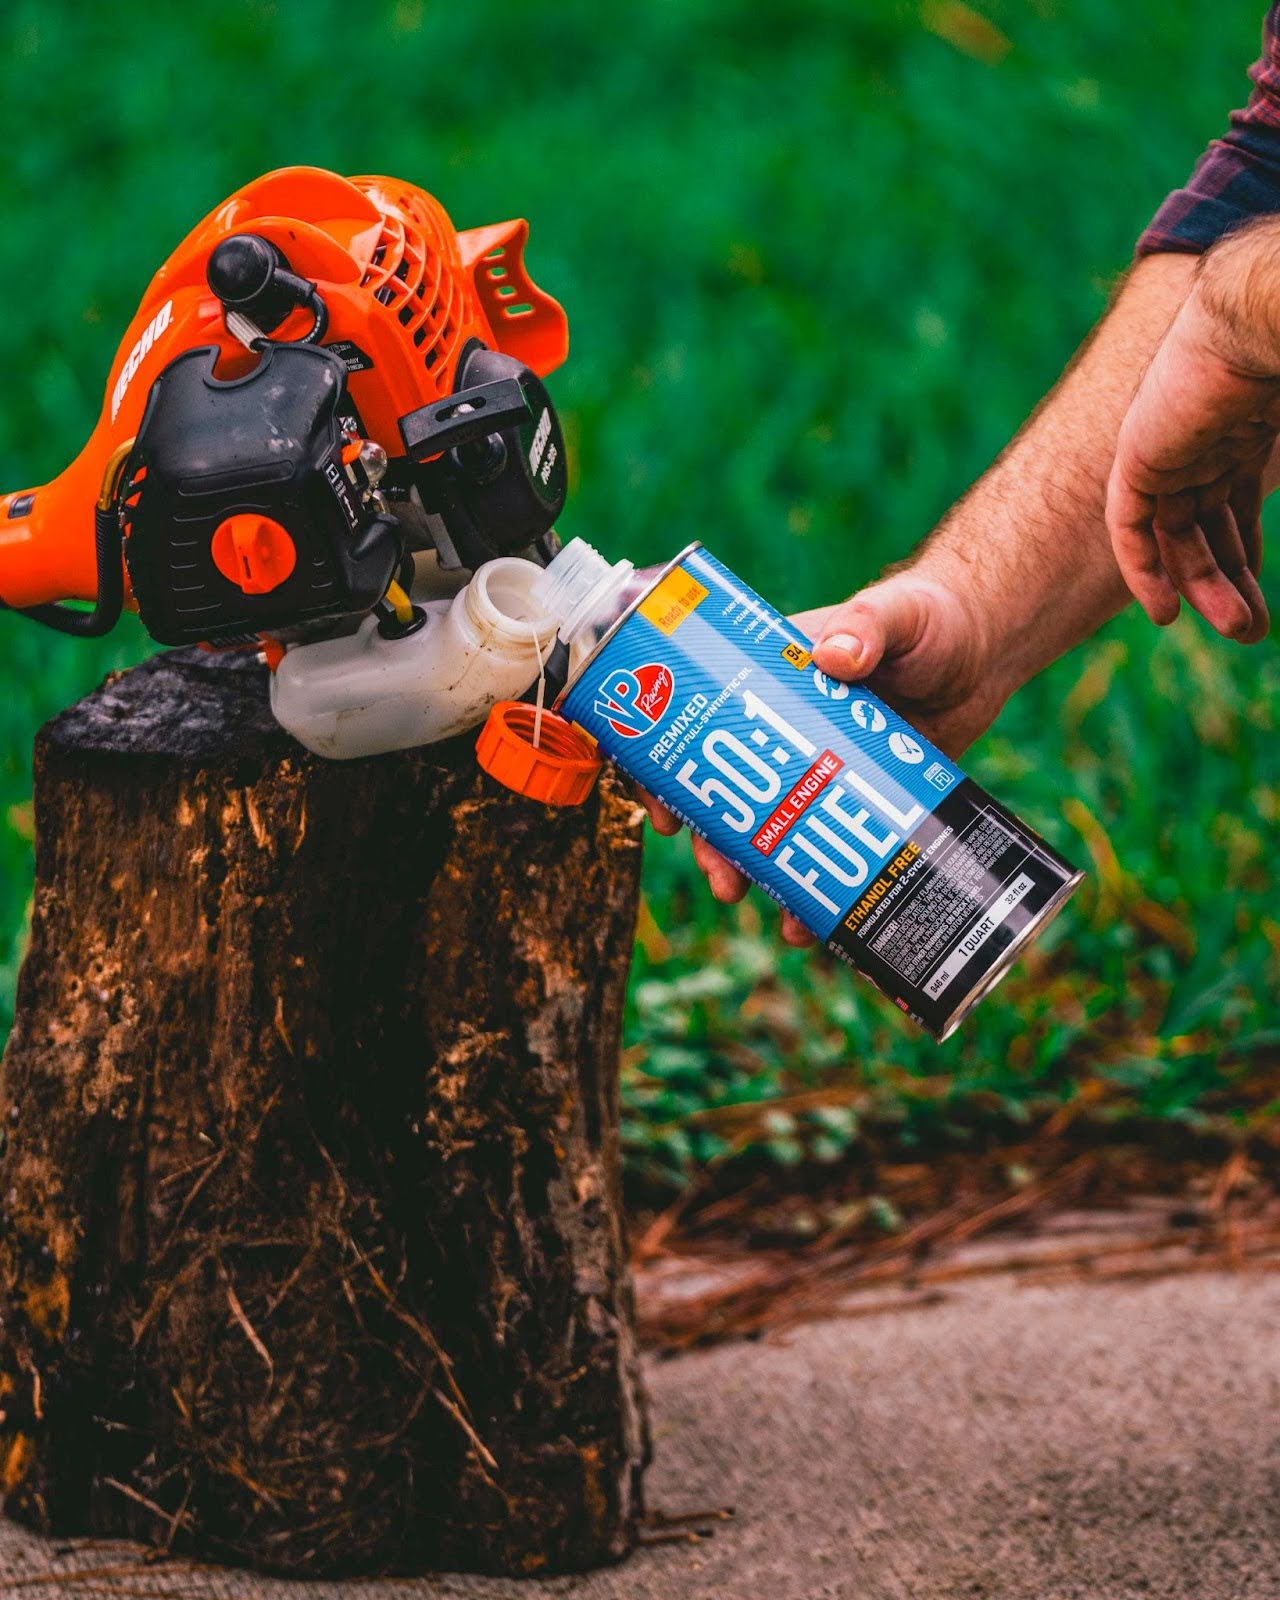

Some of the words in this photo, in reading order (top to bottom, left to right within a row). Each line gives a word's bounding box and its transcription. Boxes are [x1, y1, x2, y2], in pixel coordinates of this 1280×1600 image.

[111, 300, 173, 424] ECHO
[659, 605, 684, 628] Ready
[679, 597, 691, 608] to
[640, 667, 669, 715] Racing
[786, 645, 803, 661] 94
[594, 668, 656, 735] VP
[648, 693, 708, 764] PREMIXED
[661, 751, 679, 772] WITH
[675, 741, 687, 755] VP
[683, 677, 742, 744] FULL-SYNTHETIC
[737, 664, 753, 681] OIL
[675, 689, 817, 833] 50:1
[934, 770, 951, 786] FD
[755, 805, 795, 851] SMALL
[788, 754, 838, 809] ENGINE
[773, 769, 924, 916] FUEL
[856, 896, 891, 938] FORMULATED
[888, 883, 903, 899] FOR
[898, 852, 929, 885] 2-CYCLE
[925, 824, 954, 855] ENGINES
[844, 879, 893, 931] ETHANOL
[887, 841, 922, 879] FREE
[871, 919, 901, 952] DANGER!
[896, 893, 923, 924] EXTREMELY
[918, 864, 948, 897] FLAMMABLE
[957, 841, 969, 853] AND
[916, 900, 938, 923] GROUND
[934, 892, 944, 902] OR
[940, 878, 956, 895] BOND
[923, 889, 937, 904] TAKE
[927, 911, 937, 922] OR
[902, 963, 915, 976] READ
[911, 947, 927, 965] OTHER
[923, 922, 949, 951] WARNINGS
[945, 914, 955, 925] ON
[951, 899, 968, 917] BACK
[911, 938, 925, 953] CALL
[914, 957, 929, 973] LEGAL
[924, 948, 937, 960] FOR
[932, 938, 945, 951] USE
[940, 932, 950, 941] IN
[945, 915, 965, 936] MOTOR
[960, 892, 984, 918] VEHICLES
[940, 971, 950, 982] ml
[958, 948, 968, 957] 1
[964, 917, 995, 951] QUART
[1004, 892, 1016, 905] 32
[1018, 882, 1028, 891] oz
